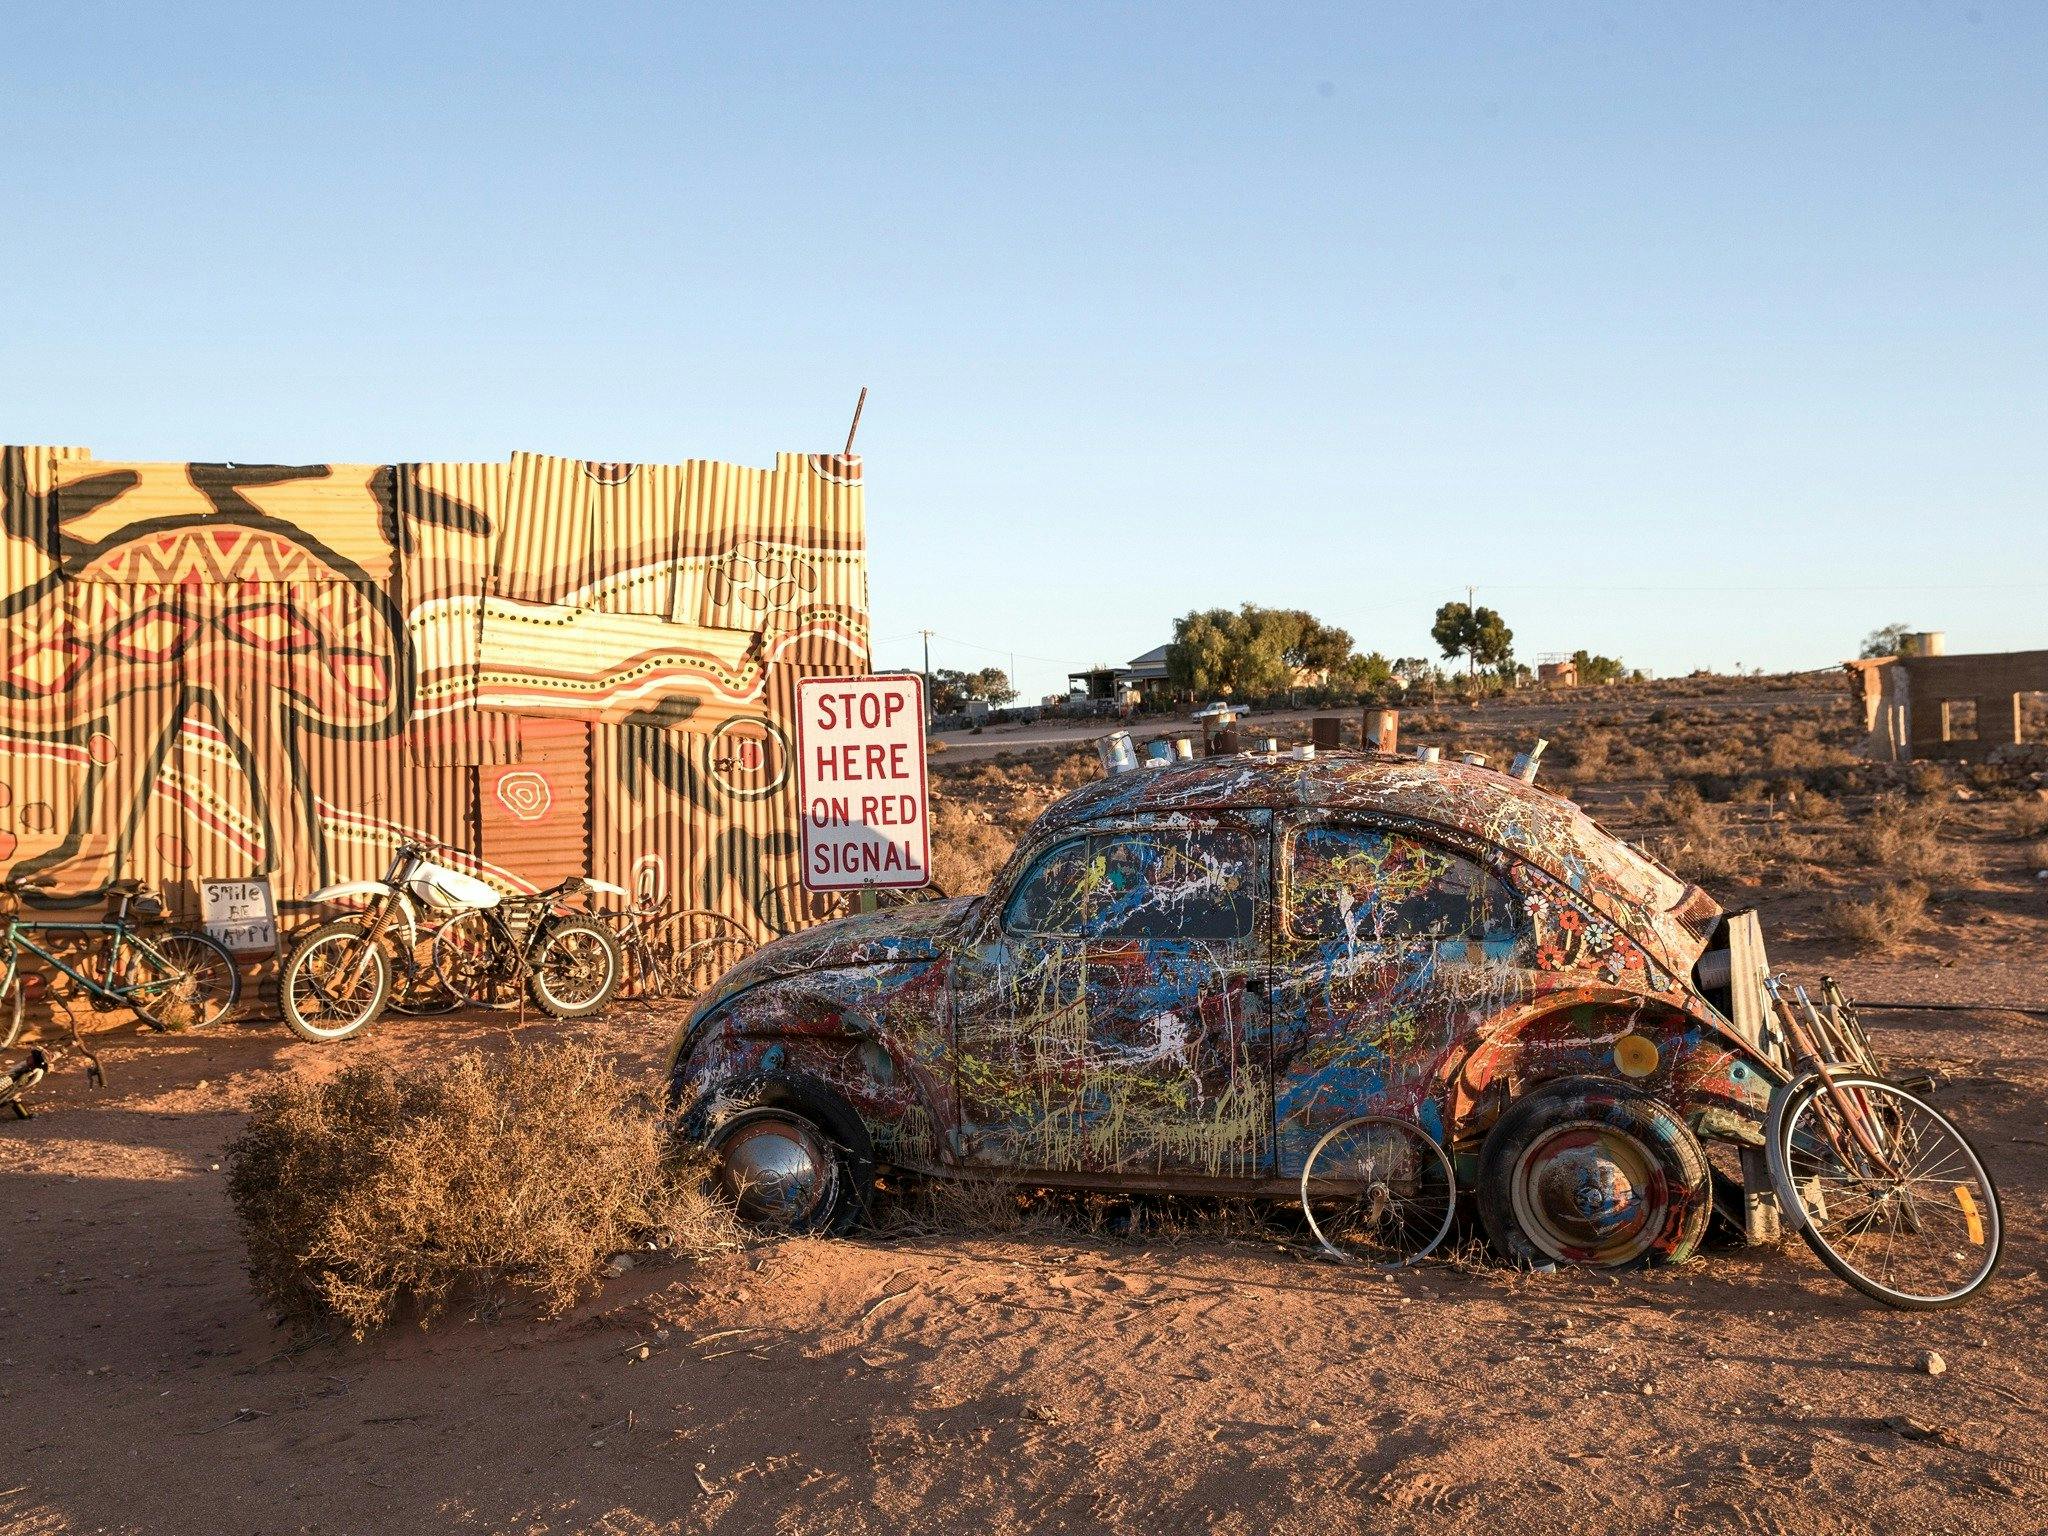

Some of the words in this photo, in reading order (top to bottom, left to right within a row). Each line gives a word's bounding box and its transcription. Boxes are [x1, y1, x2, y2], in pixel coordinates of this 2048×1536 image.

[817, 692, 905, 730] STOP
[816, 743, 910, 781] HERE
[811, 797, 850, 829] ON
[861, 795, 917, 826] RED
[813, 840, 921, 874] SIGNAL
